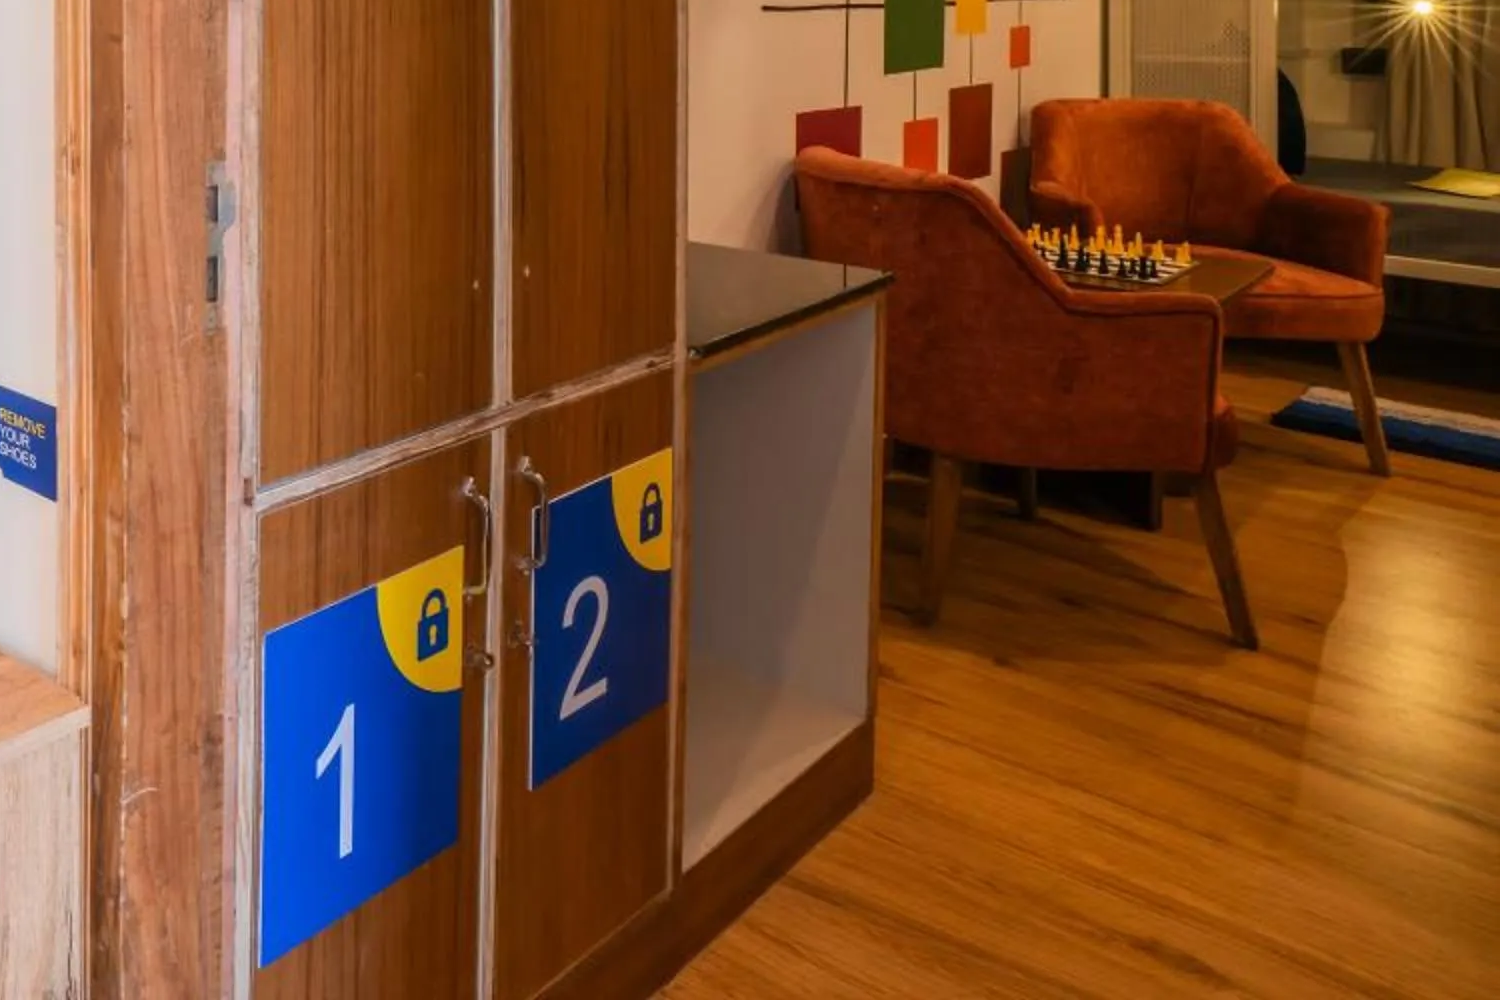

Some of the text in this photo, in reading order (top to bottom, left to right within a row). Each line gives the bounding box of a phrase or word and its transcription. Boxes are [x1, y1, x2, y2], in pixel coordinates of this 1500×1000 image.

[0, 407, 46, 439] REMOVE
[0, 424, 30, 451] YOUR
[0, 441, 37, 469] SHOES
[559, 575, 609, 721] 2
[315, 703, 355, 859] 1
